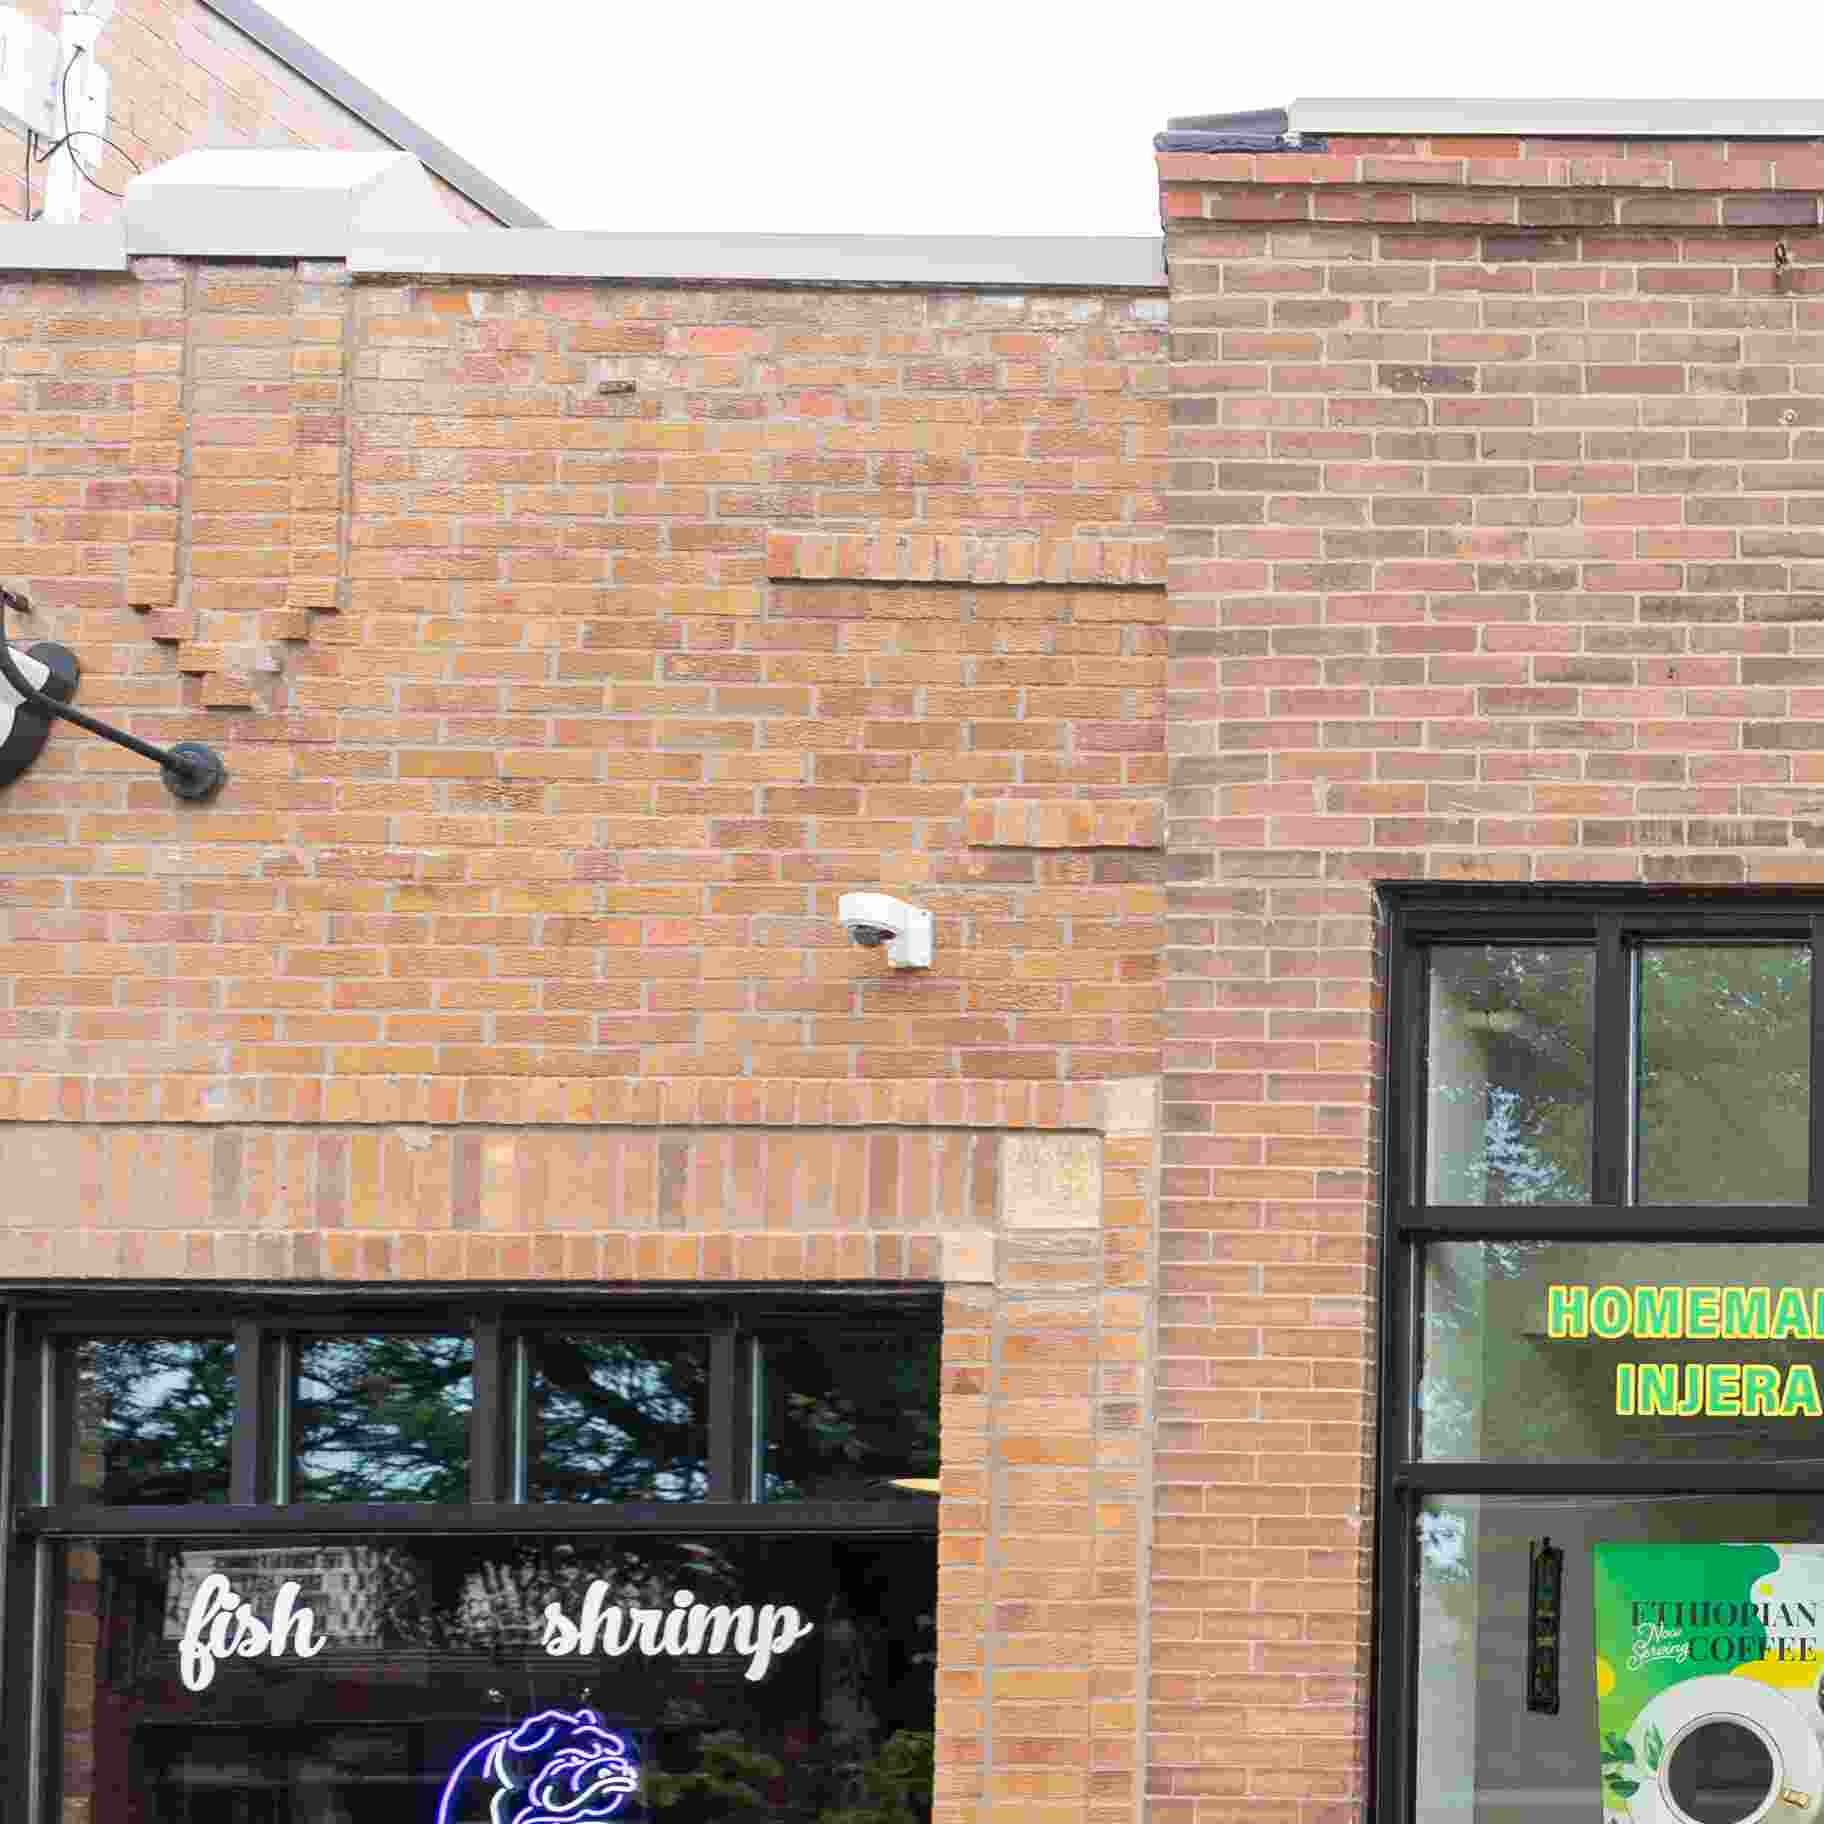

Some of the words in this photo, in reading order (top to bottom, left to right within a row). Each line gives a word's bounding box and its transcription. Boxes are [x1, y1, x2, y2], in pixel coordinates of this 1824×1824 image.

[1615, 1363, 1824, 1417] INJERA
[178, 1573, 327, 1692] fish
[541, 1579, 814, 1682] shrimp
[1632, 1601, 1817, 1627] ETHIOPIAN
[1689, 1636, 1817, 1663] COFFEE
